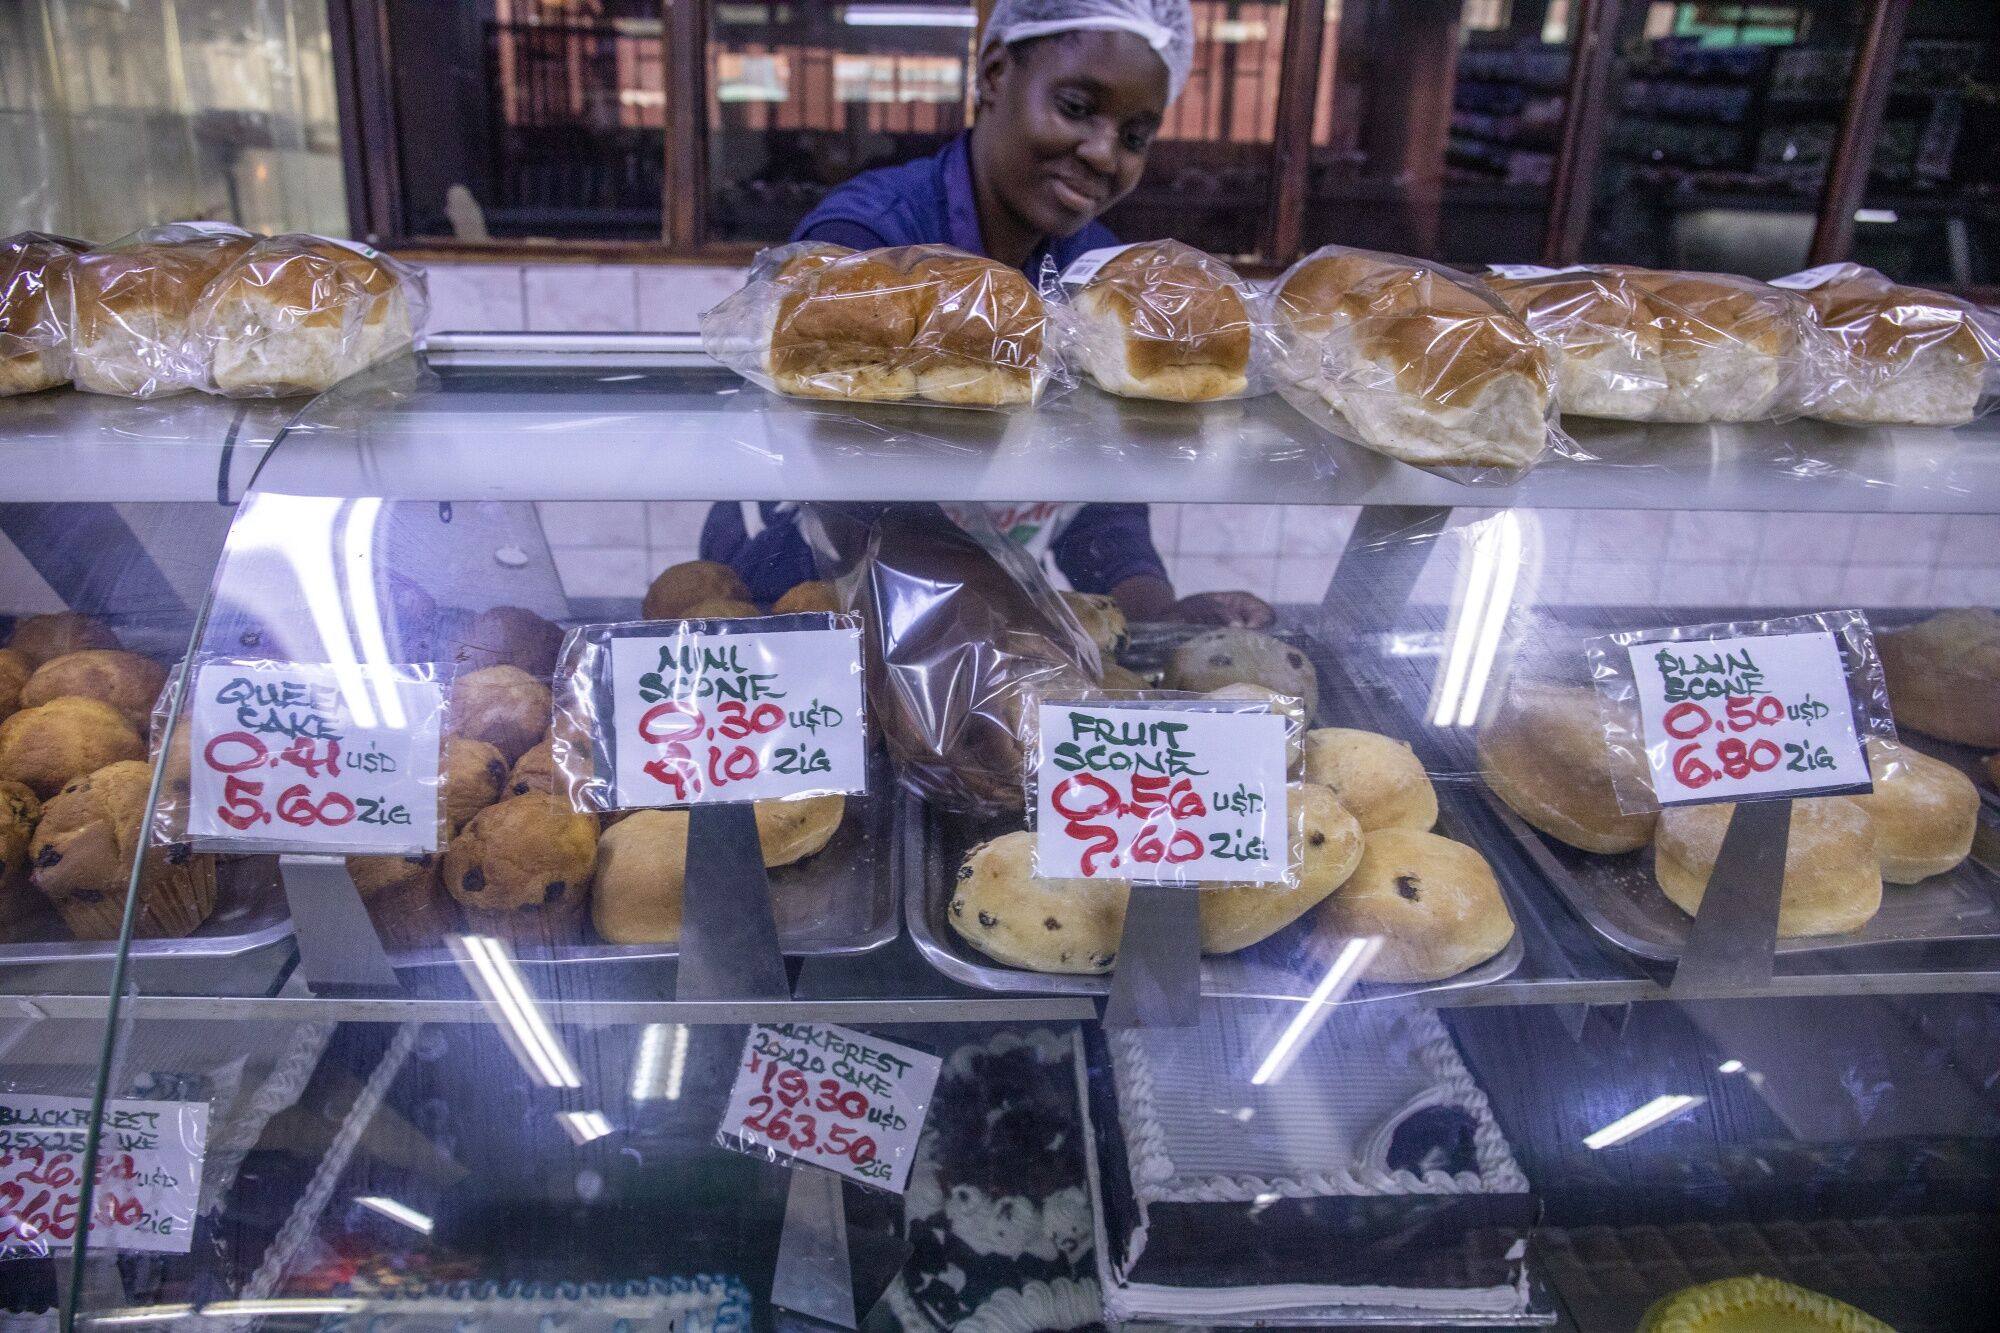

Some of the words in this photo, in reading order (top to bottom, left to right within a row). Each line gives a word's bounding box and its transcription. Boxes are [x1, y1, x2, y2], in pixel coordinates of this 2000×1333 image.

[1655, 647, 1760, 679] PLAIN
[639, 672, 787, 703] SCONE
[1664, 672, 1772, 703] SCONE
[237, 704, 344, 740] CAKE
[639, 700, 786, 744] 0.30
[1069, 711, 1189, 748] FRUIT
[1663, 695, 1785, 740] 0.50
[204, 731, 341, 778] 0.41
[1053, 742, 1210, 777] SCONE
[1673, 737, 1781, 789] 6.80
[217, 775, 356, 830] 5.60
[1051, 772, 1208, 822] 0.56
[1064, 820, 1205, 877] 7.60
[757, 1023, 913, 1079] ACKFOREST
[832, 1060, 893, 1099] CAKE
[0, 1105, 160, 1131] BLACKFREST
[742, 1095, 876, 1165] 263.50
